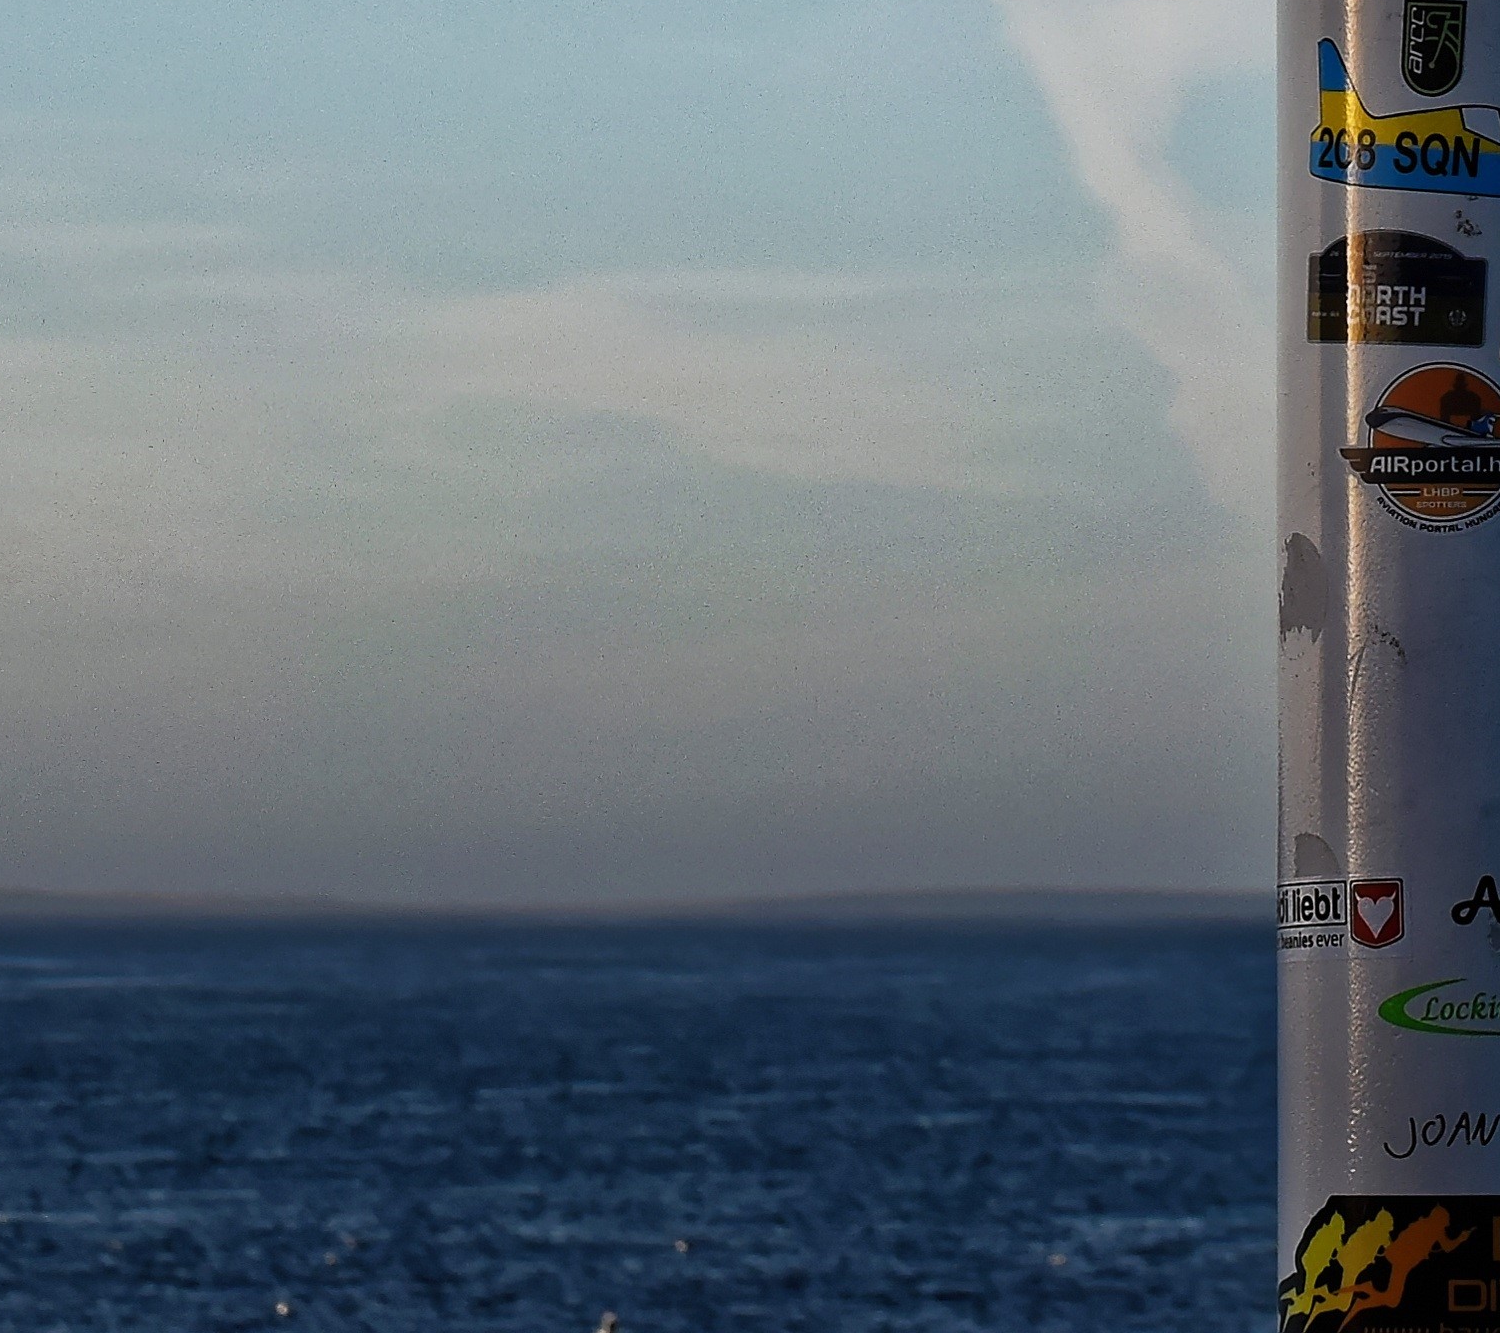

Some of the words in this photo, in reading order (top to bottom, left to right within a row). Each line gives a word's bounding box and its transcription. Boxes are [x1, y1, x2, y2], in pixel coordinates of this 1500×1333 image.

[1409, 6, 1425, 74] arcc
[1318, 127, 1376, 170] 208
[1393, 131, 1481, 178] SQN
[1423, 487, 1460, 497] LHBP
[1376, 496, 1417, 529] AVIATION
[1419, 523, 1463, 533] PORTAL
[1292, 887, 1341, 922] liebt
[1316, 933, 1345, 947] ever
[1383, 1111, 1500, 1159] JOAN
